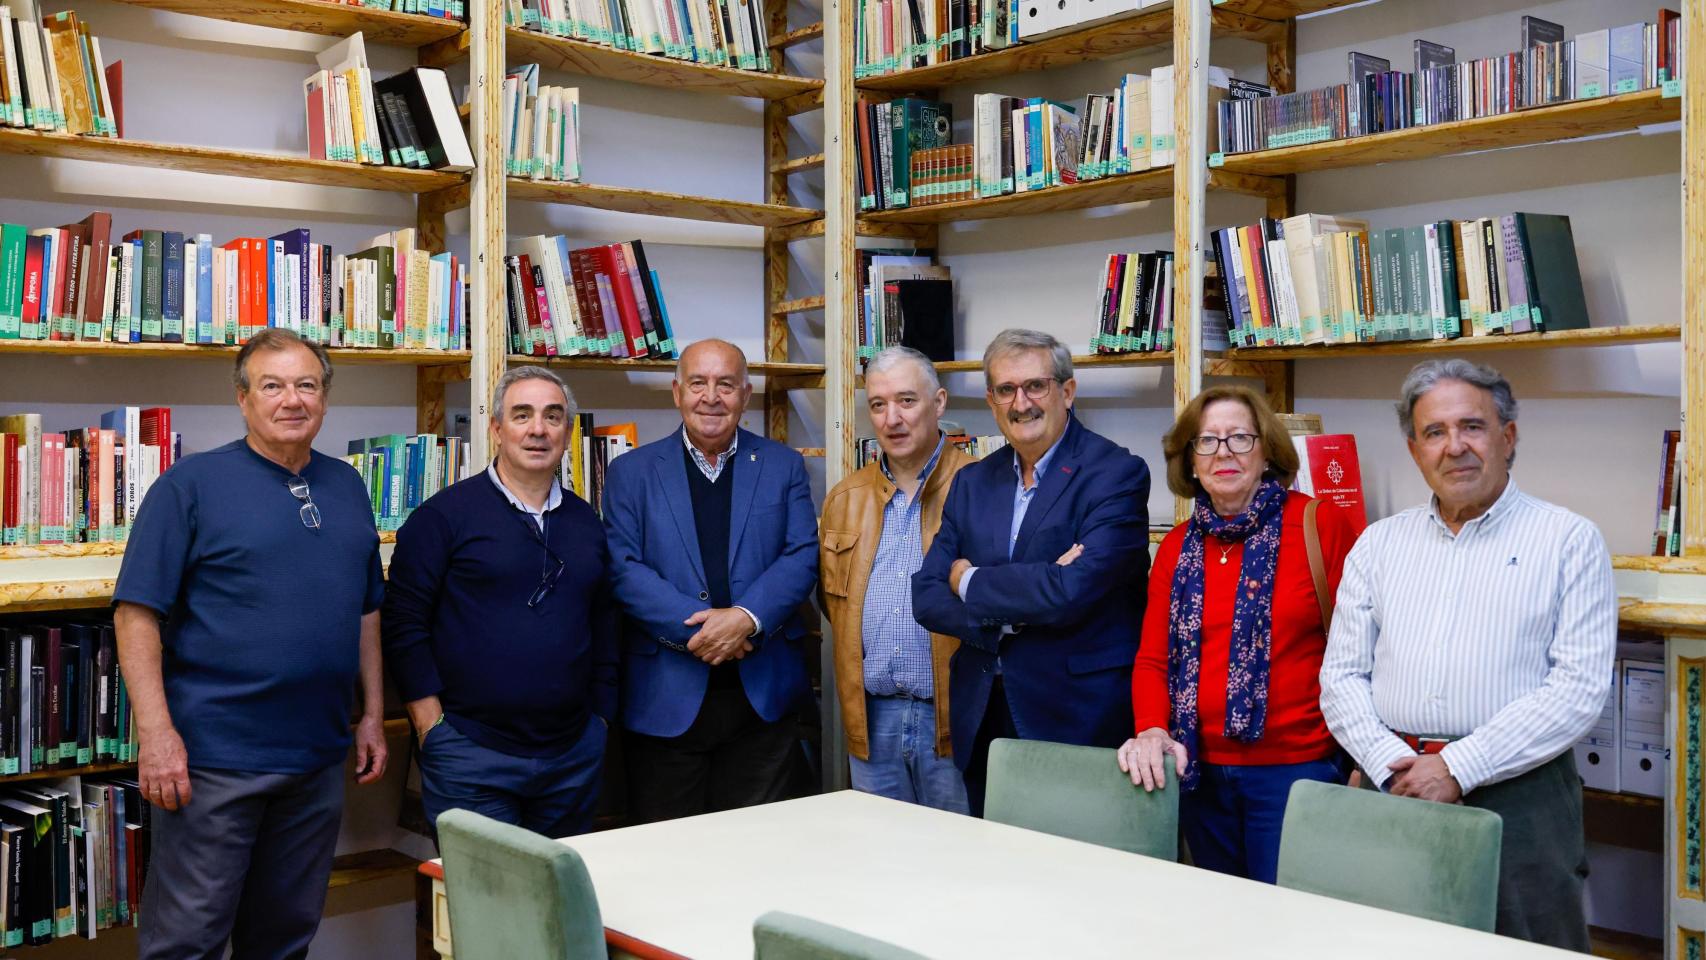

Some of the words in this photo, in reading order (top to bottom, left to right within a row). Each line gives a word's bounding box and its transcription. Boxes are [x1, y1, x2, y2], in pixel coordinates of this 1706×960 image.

[479, 252, 484, 262] 4
[480, 405, 485, 415] 3
[391, 474, 400, 516] SENDERISMO
[1664, 749, 1671, 760] 2
